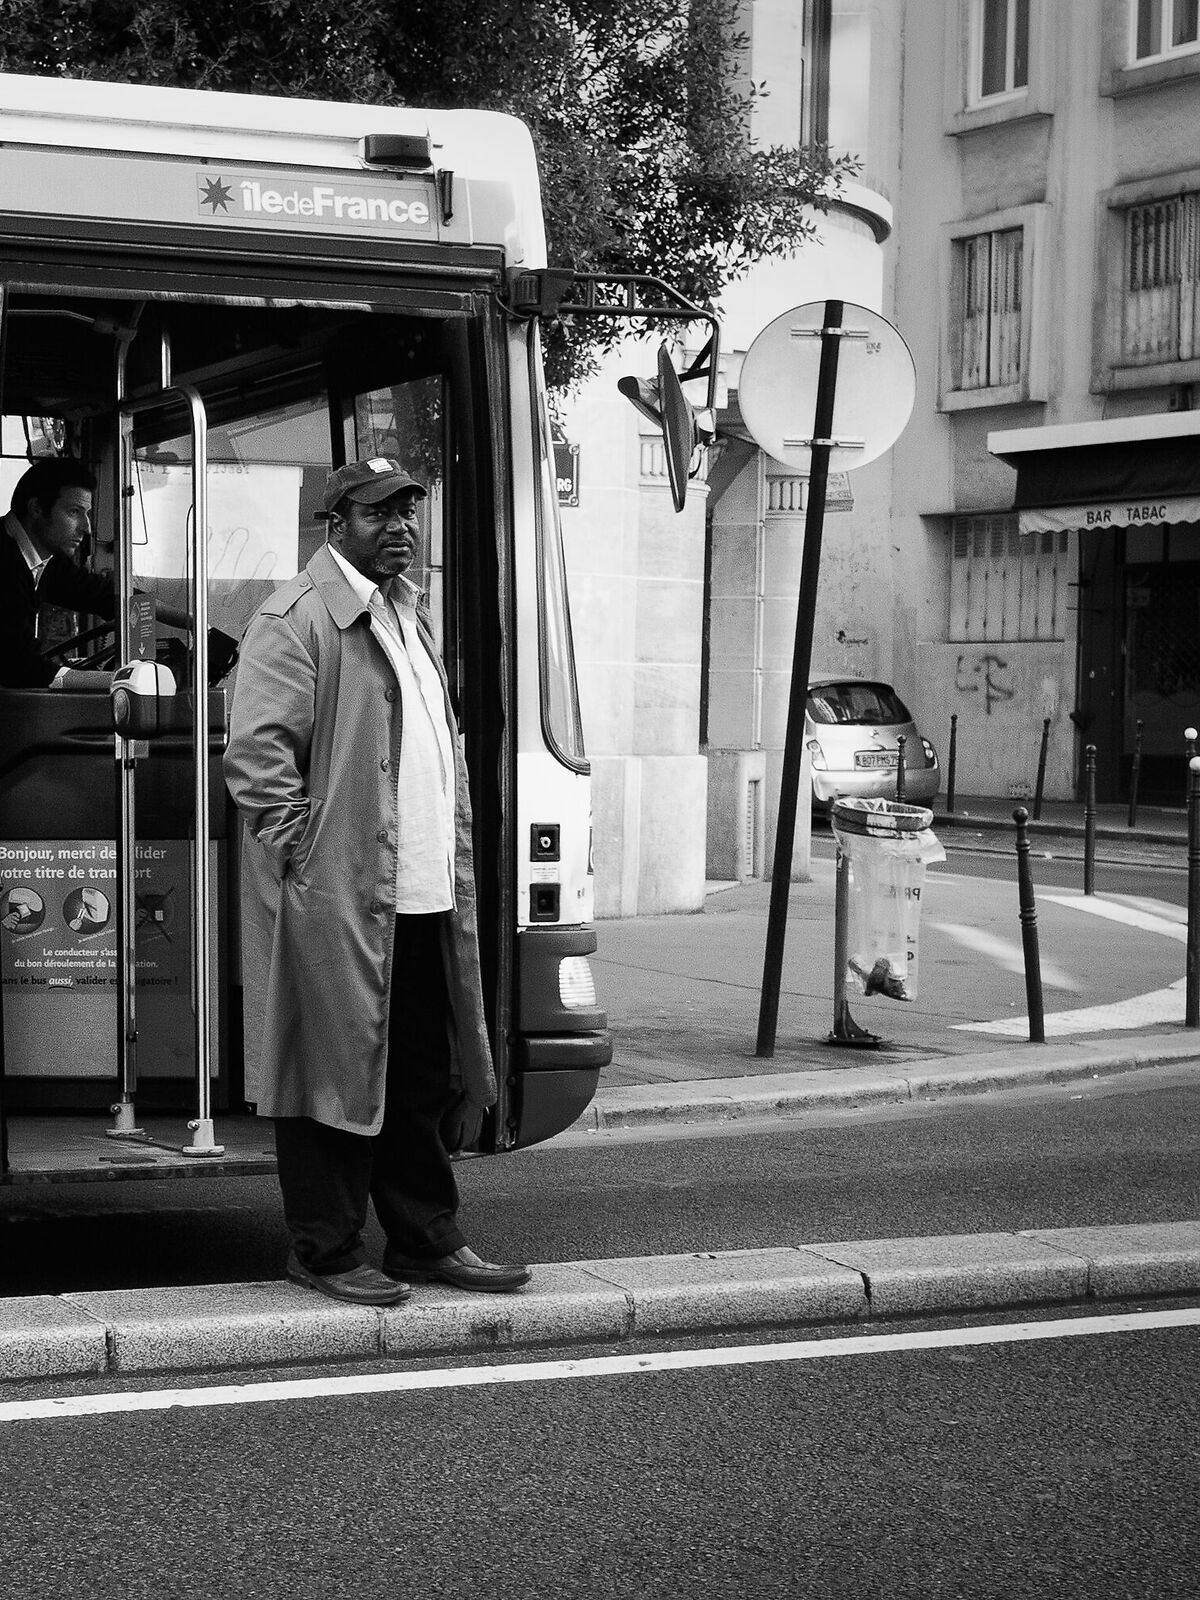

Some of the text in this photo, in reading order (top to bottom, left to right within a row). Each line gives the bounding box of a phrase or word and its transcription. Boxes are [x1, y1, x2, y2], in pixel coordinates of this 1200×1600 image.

[1086, 505, 1167, 524] BAR TABAC
[0, 847, 54, 863] Bonjour,
[58, 846, 96, 860] merci
[100, 846, 117, 860] de
[34, 866, 64, 879] titre
[68, 865, 86, 879] de
[43, 948, 53, 957] Le
[54, 948, 98, 957] conducteur
[14, 959, 25, 968] du
[26, 959, 42, 968] bon
[95, 959, 107, 968] de
[108, 959, 116, 968] la
[20, 976, 29, 985] le
[31, 976, 46, 985] bus
[48, 975, 74, 987] aussi,
[75, 976, 107, 985] valider
